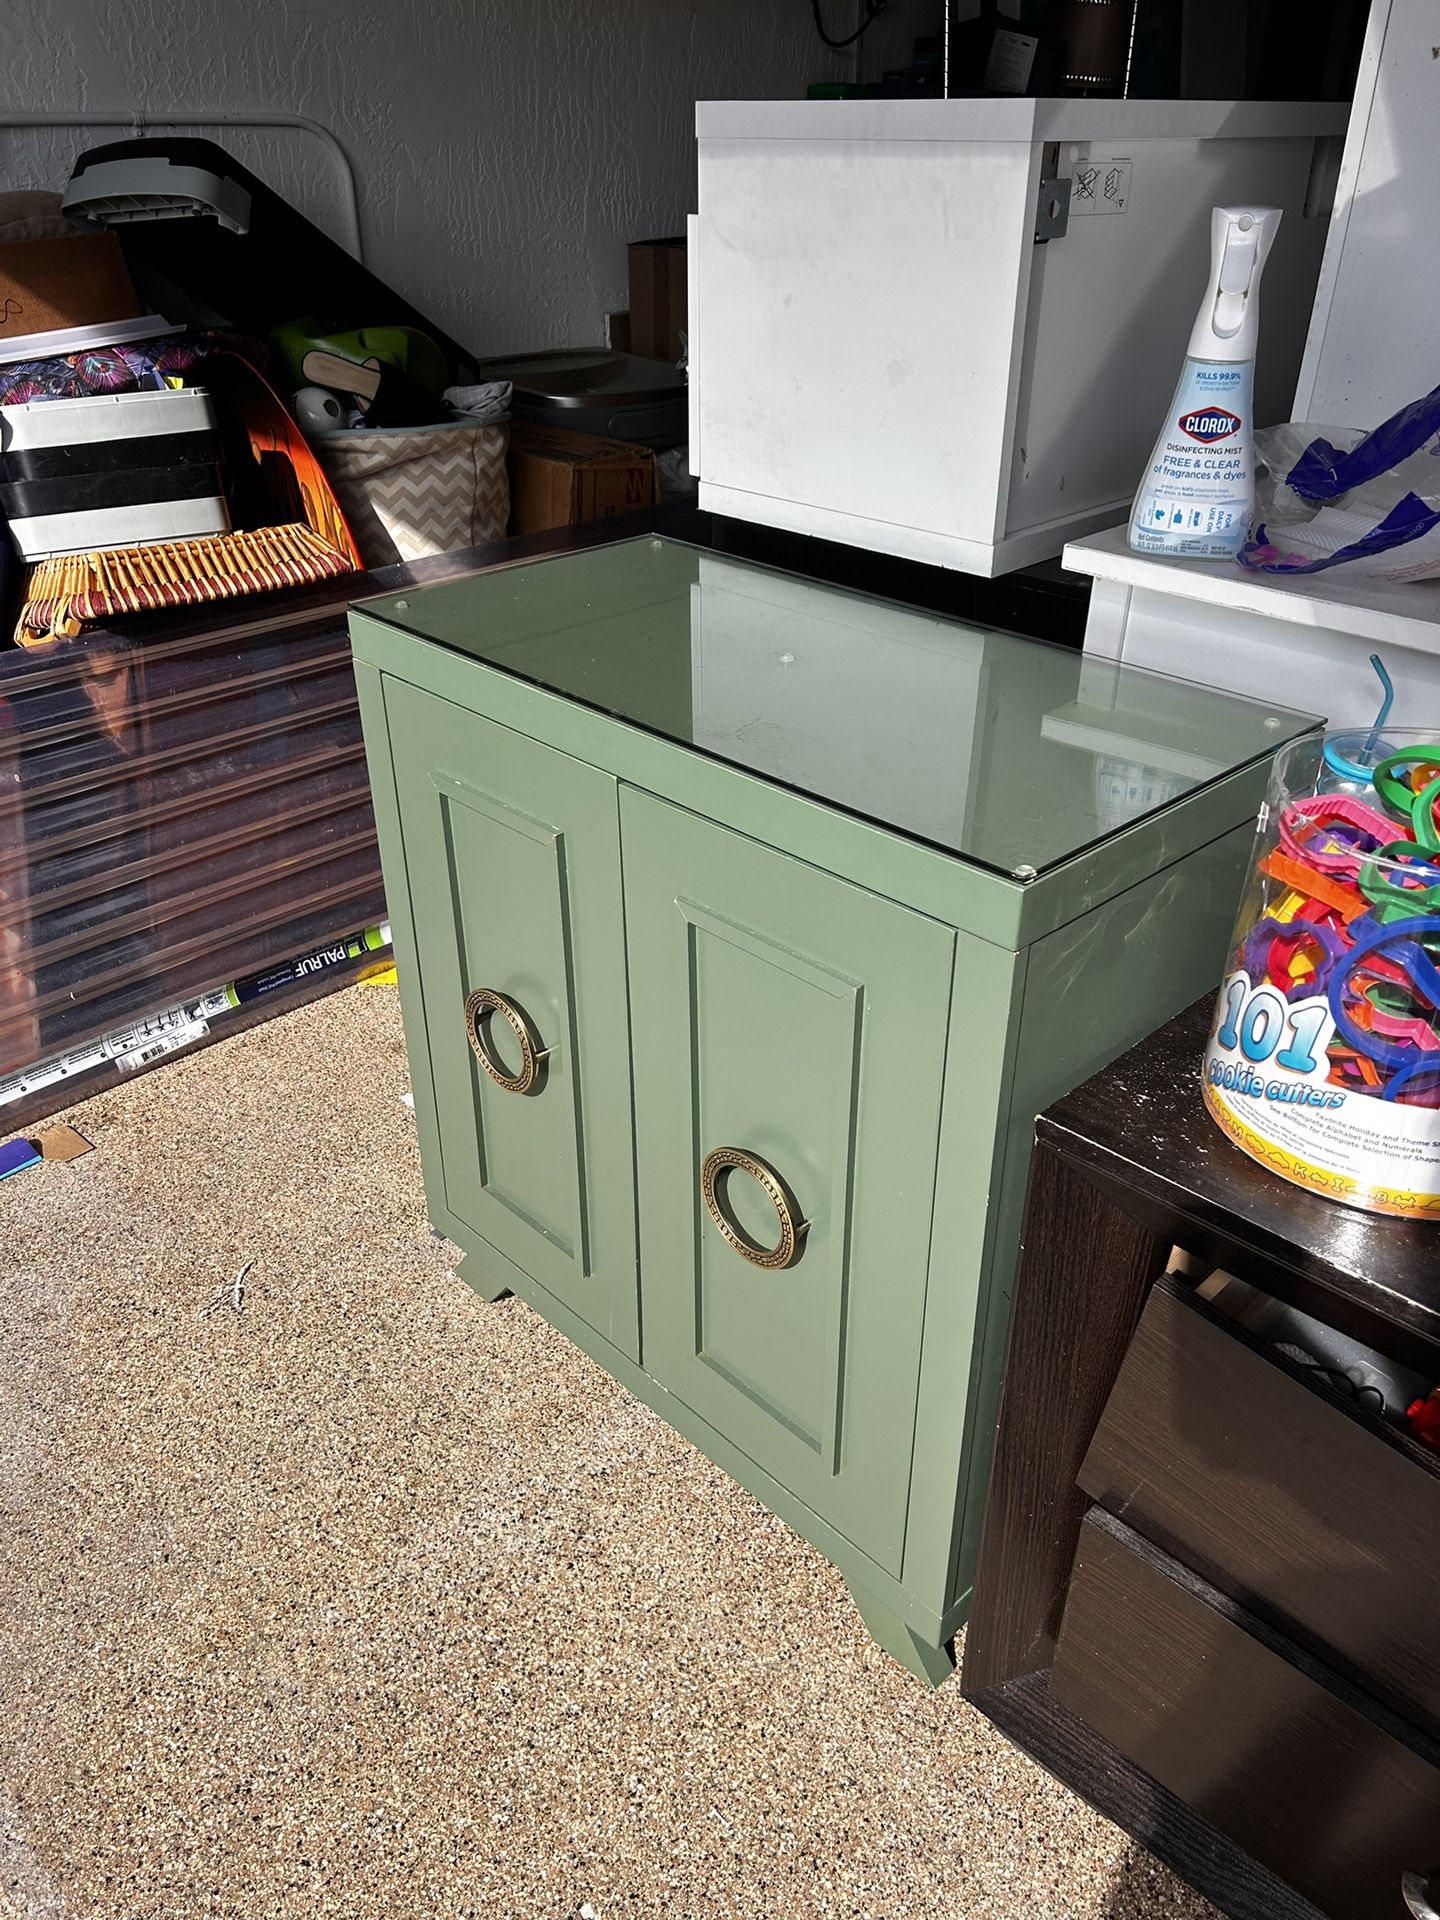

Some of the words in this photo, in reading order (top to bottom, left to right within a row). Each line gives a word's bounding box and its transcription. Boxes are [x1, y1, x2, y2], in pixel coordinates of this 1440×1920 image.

[1197, 372, 1218, 380] KILLS
[1219, 372, 1241, 380] 99.9%
[1186, 416, 1235, 433] CLOROX
[1167, 443, 1222, 455] DISINFECTING
[1224, 447, 1243, 455] MIST
[1163, 455, 1191, 467] FREE
[1193, 459, 1201, 468] &
[1204, 460, 1241, 469] CLEAR
[1153, 465, 1162, 473] of
[1163, 466, 1211, 479] fragrances
[1213, 471, 1220, 480] &
[1223, 471, 1246, 481] dyes
[1207, 507, 1216, 520] USE
[1216, 511, 1224, 531] DAILY
[1224, 513, 1232, 528] FOR
[1206, 521, 1213, 533] ON
[295, 946, 346, 978] PALRUF
[1218, 979, 1328, 1074] 101
[1209, 1056, 1265, 1098] cookie
[1266, 1080, 1347, 1109] cutters
[1270, 1104, 1281, 1115] See
[1283, 1112, 1308, 1129] Bottom
[1309, 1125, 1320, 1134] for
[1322, 1131, 1360, 1148] Complete
[1362, 1144, 1401, 1158] Selection
[1291, 1107, 1324, 1128] Complete
[1326, 1124, 1361, 1141] Alphabet
[1364, 1138, 1380, 1146] and
[1382, 1141, 1423, 1154] Numerals
[1316, 1111, 1347, 1128] Favorite
[1349, 1124, 1380, 1138] Holiday
[1401, 1137, 1430, 1147] Theme
